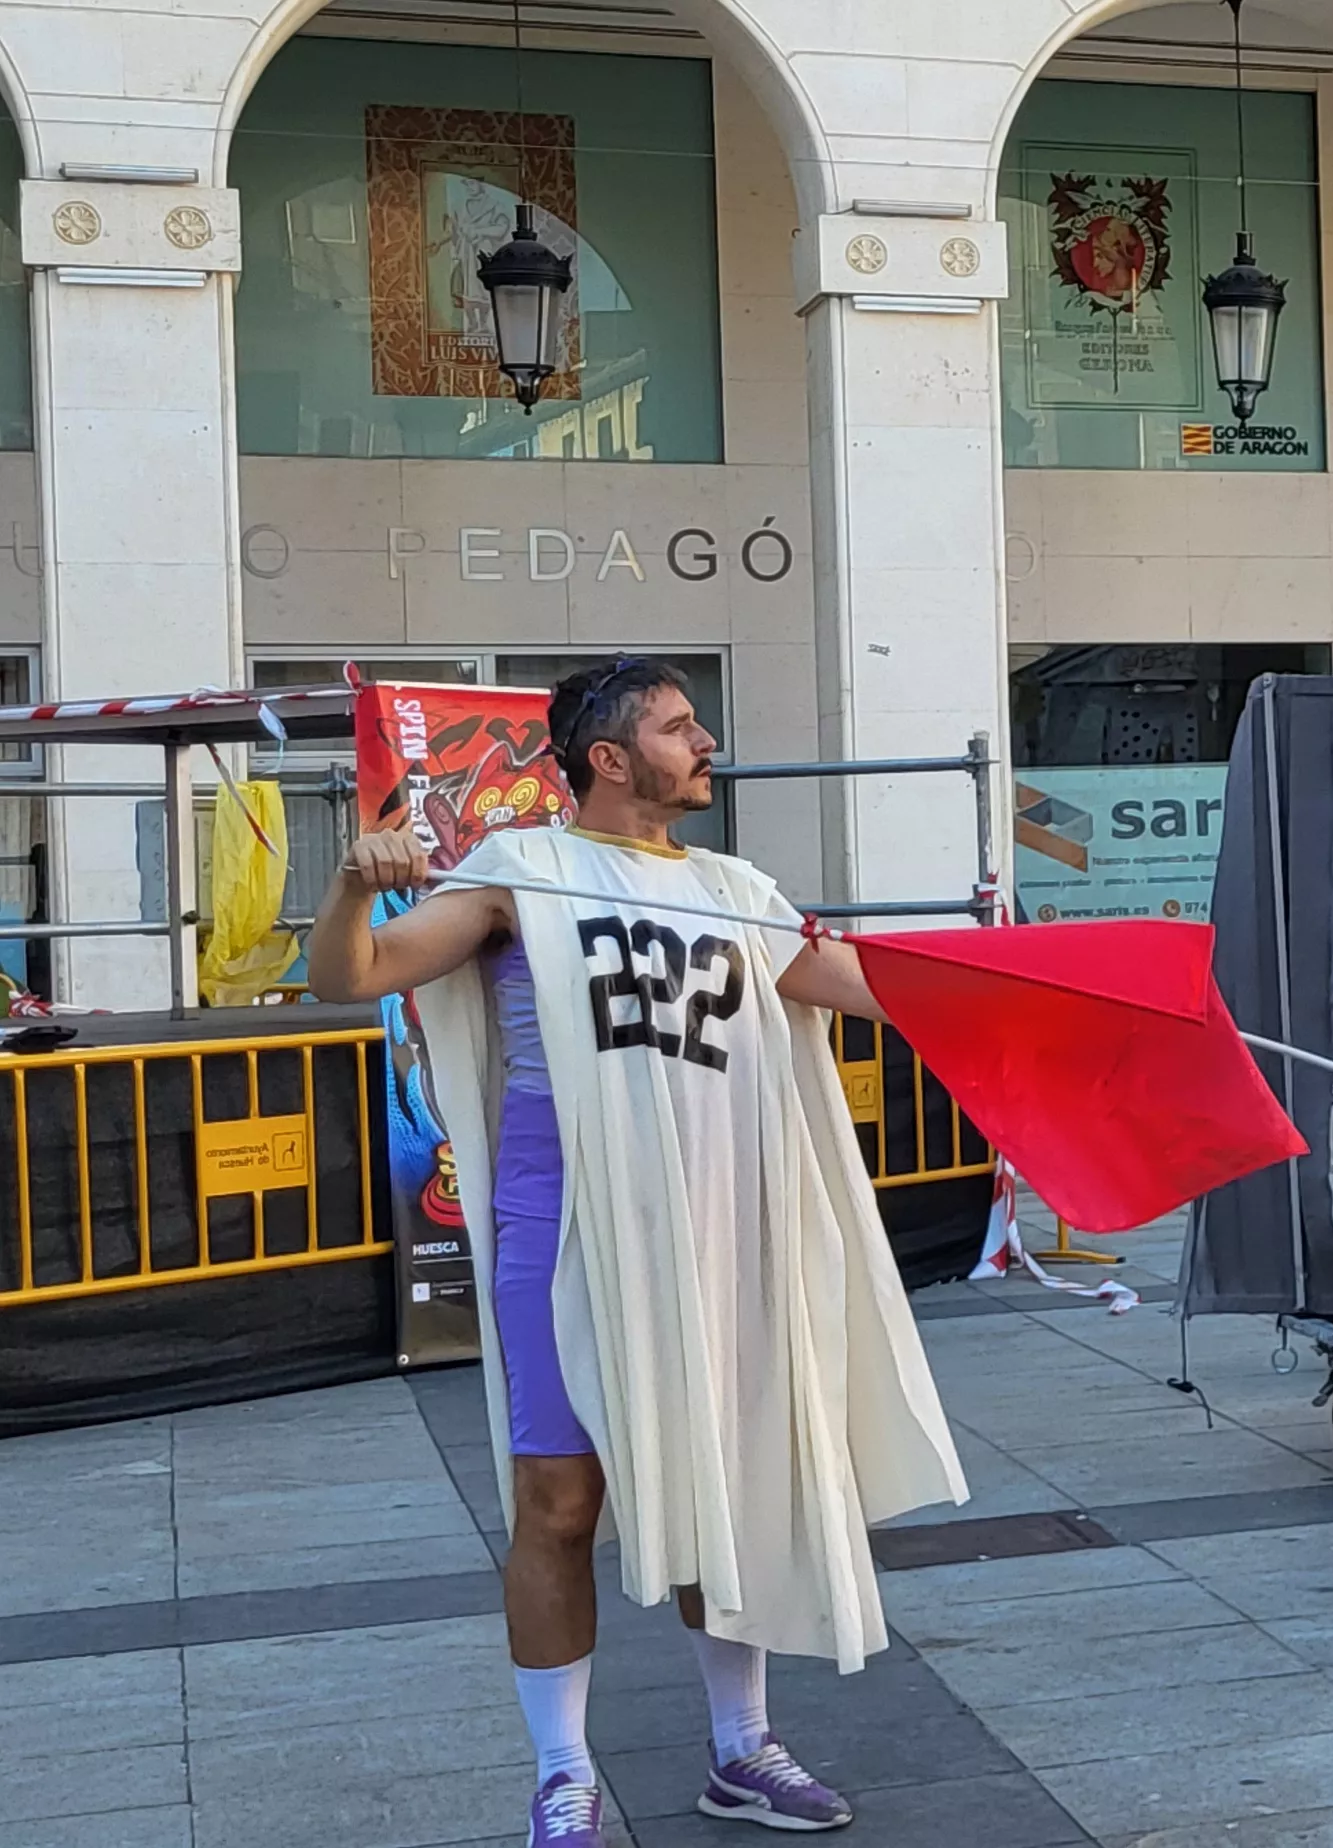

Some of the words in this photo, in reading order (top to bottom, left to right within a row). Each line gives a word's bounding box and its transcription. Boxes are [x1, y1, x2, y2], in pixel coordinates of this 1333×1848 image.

[439, 335, 496, 347] EDITORI
[430, 345, 467, 360] LUIS
[470, 349, 499, 362] VIV
[1212, 426, 1297, 441] GOBIERNO
[1213, 441, 1235, 454] DE
[394, 698, 428, 760] SPIN
[1111, 799, 1223, 839] sar
[577, 915, 746, 1075] 222
[412, 1241, 459, 1256] HUESCA
